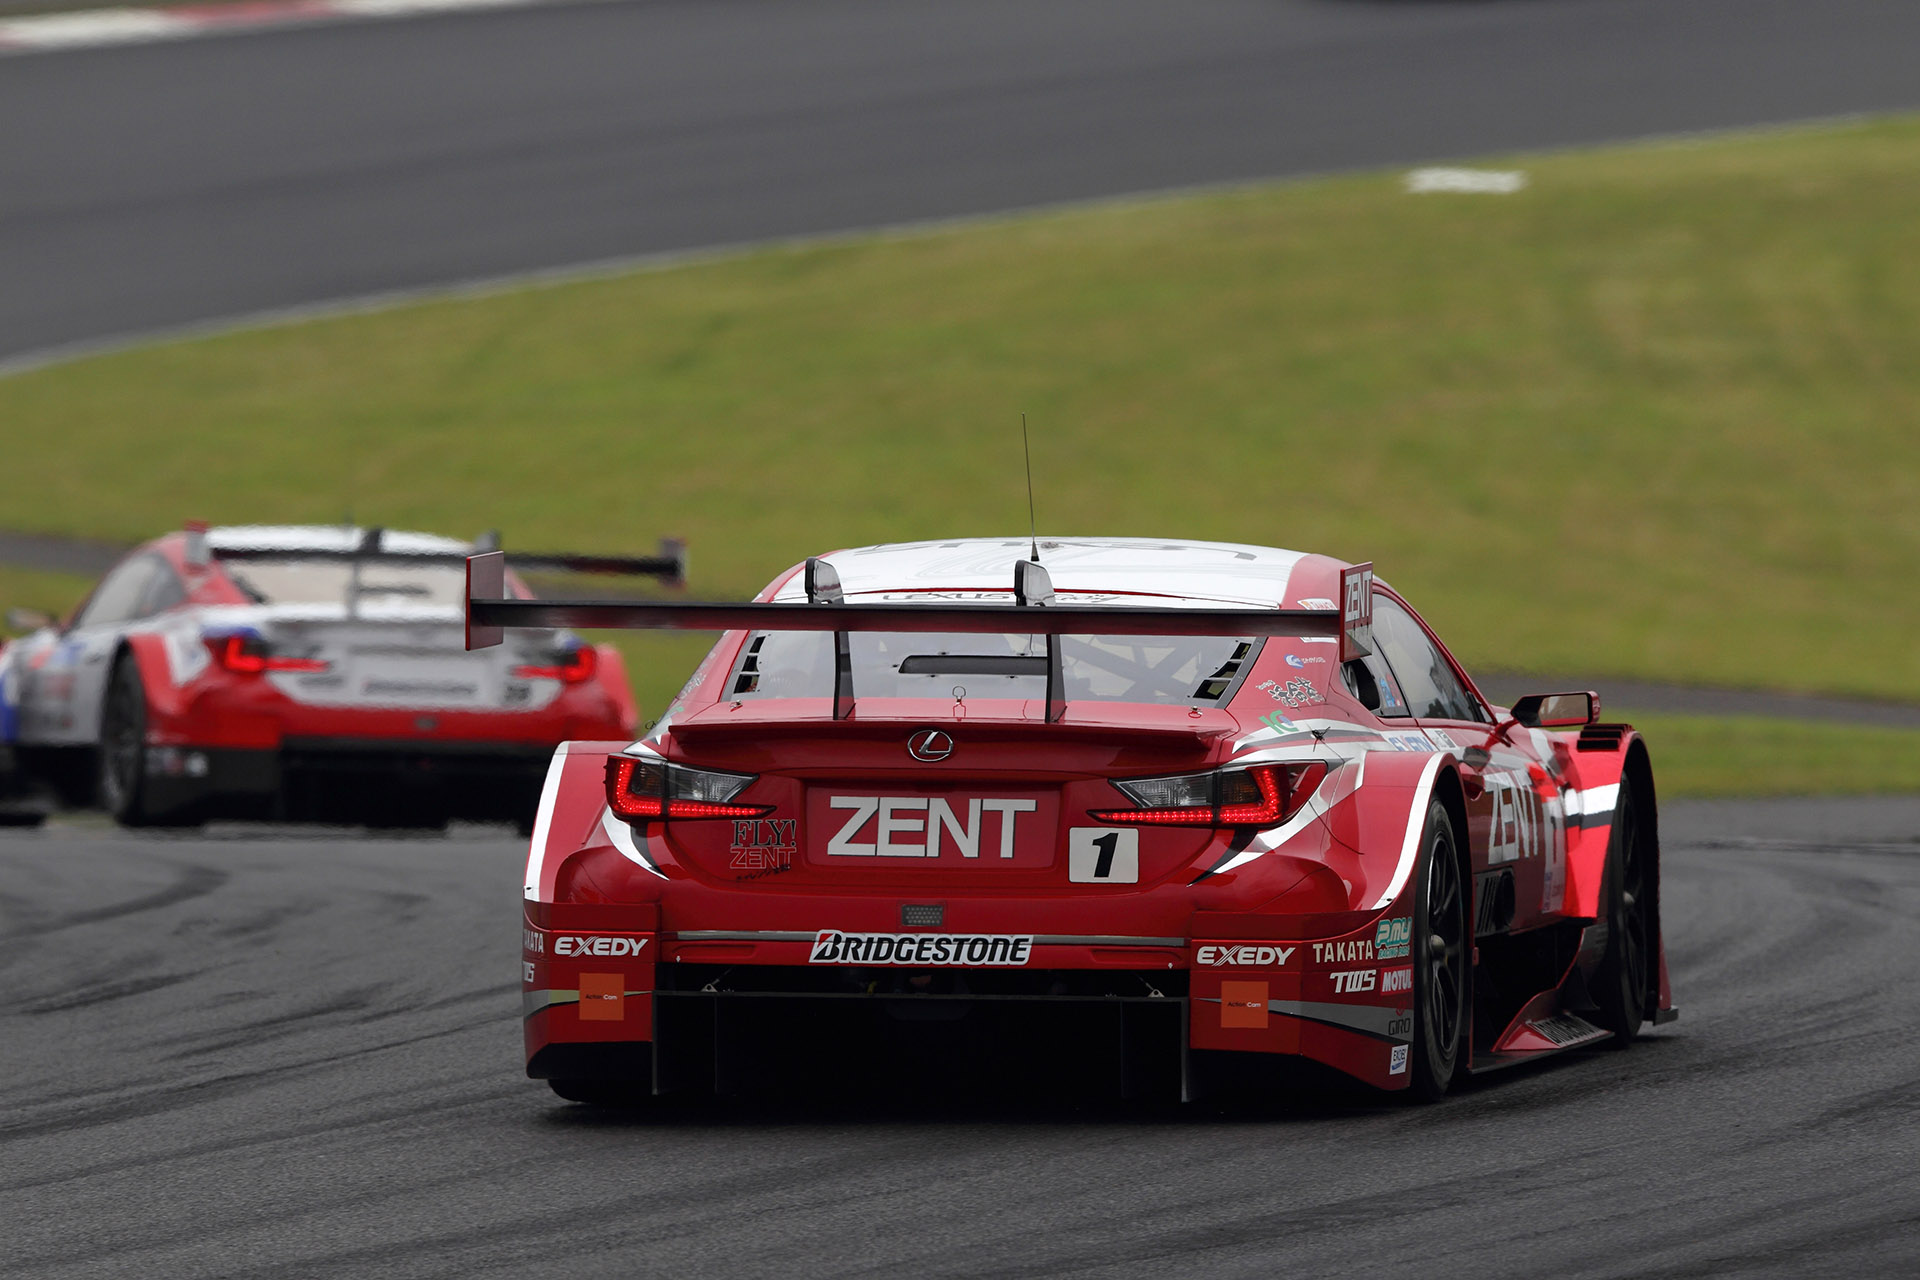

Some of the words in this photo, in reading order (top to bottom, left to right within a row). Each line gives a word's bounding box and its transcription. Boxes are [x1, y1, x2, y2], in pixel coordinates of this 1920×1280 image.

[1345, 570, 1373, 623] ZENT
[827, 796, 1037, 858] ZENT
[1483, 769, 1539, 865] ZENT
[730, 818, 797, 847] FLY!
[730, 846, 797, 869] ZENT
[1092, 832, 1119, 878] 1
[554, 936, 648, 957] EXEDY
[812, 931, 1031, 963] BRIDGESTONE
[1196, 945, 1296, 966] EXEDY
[1312, 939, 1374, 964] TAKATA
[1329, 969, 1377, 994] TWS
[1381, 967, 1412, 993] MOTUL
